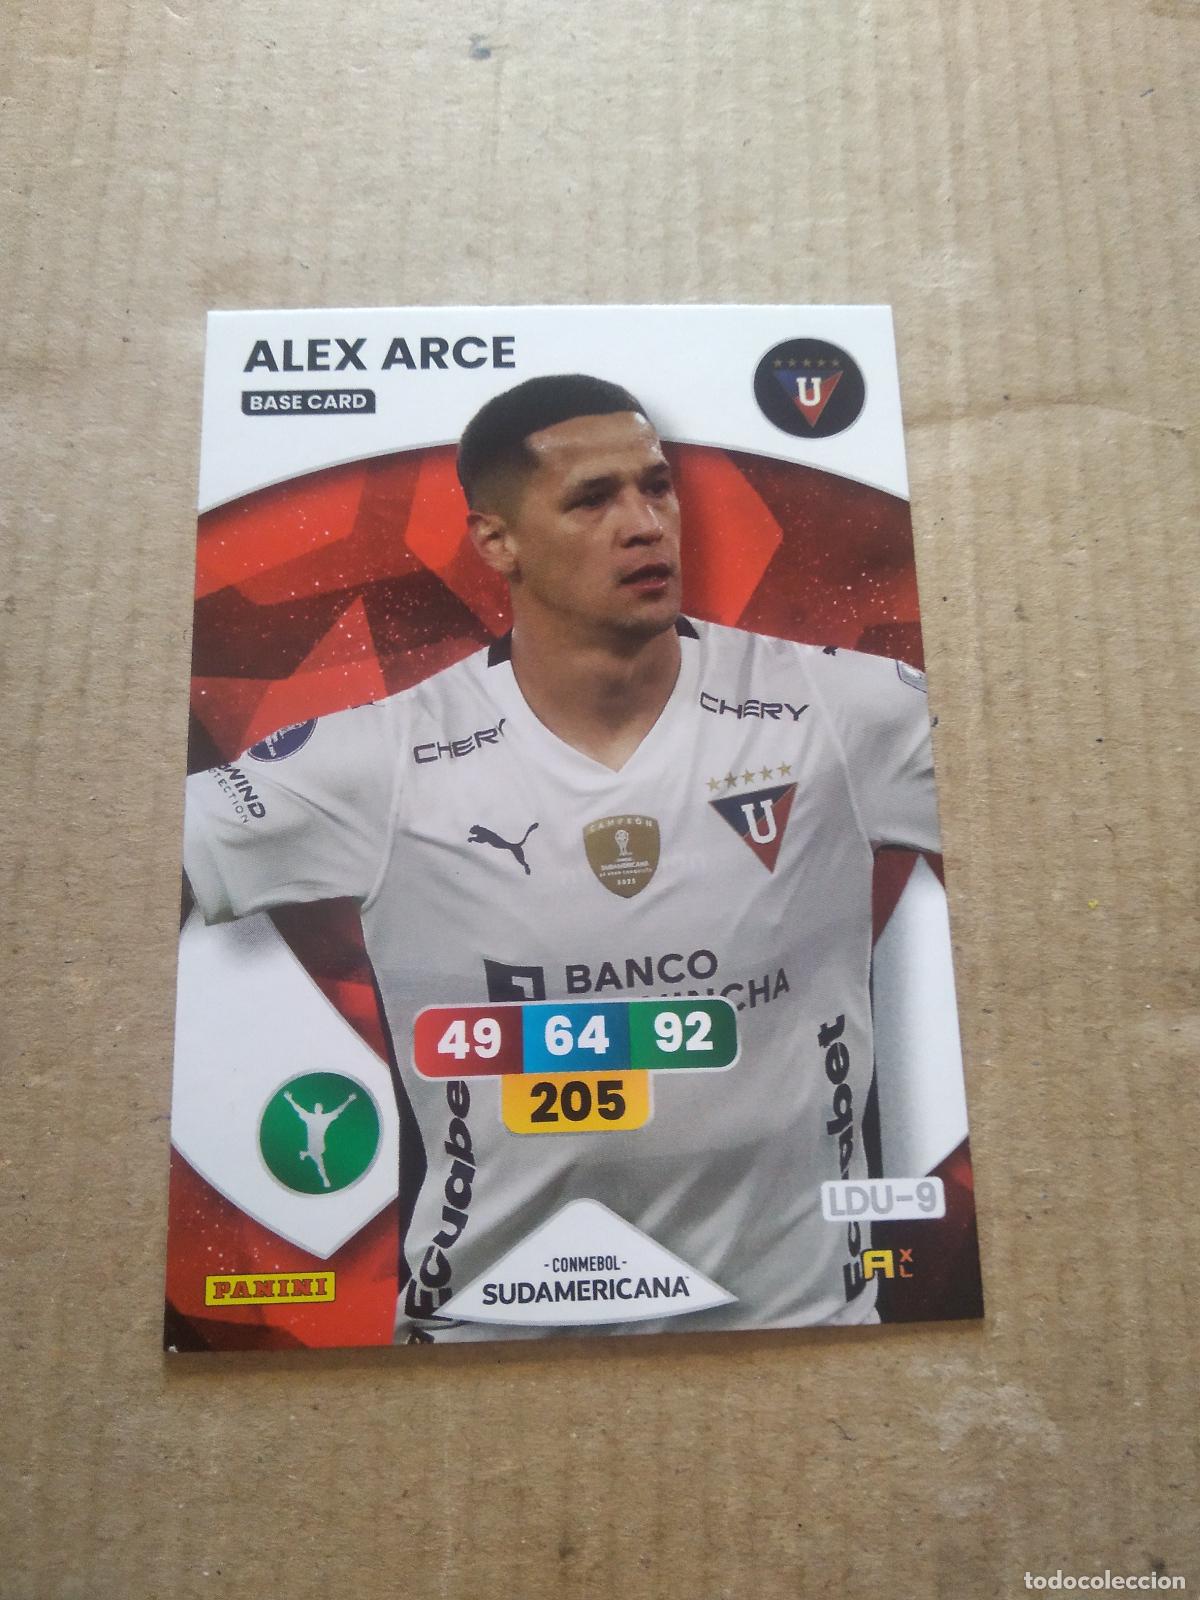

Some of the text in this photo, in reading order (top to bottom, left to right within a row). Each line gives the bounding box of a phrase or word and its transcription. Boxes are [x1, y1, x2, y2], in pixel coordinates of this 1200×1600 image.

[243, 336, 516, 373] ALEX ARCE
[250, 393, 367, 411] BASE CARD
[796, 376, 822, 407] U
[701, 691, 810, 721] CHERY
[413, 717, 506, 765] CHERY
[741, 799, 777, 845] U
[565, 949, 718, 994] BANCO
[437, 1010, 714, 1060] 49 64 92
[530, 1079, 627, 1124] 205
[404, 1080, 478, 1321] Ecuabe
[828, 1181, 937, 1217] LDU-9
[212, 1277, 329, 1300] PANINI
[482, 1276, 690, 1306] SUDAMERICANA
